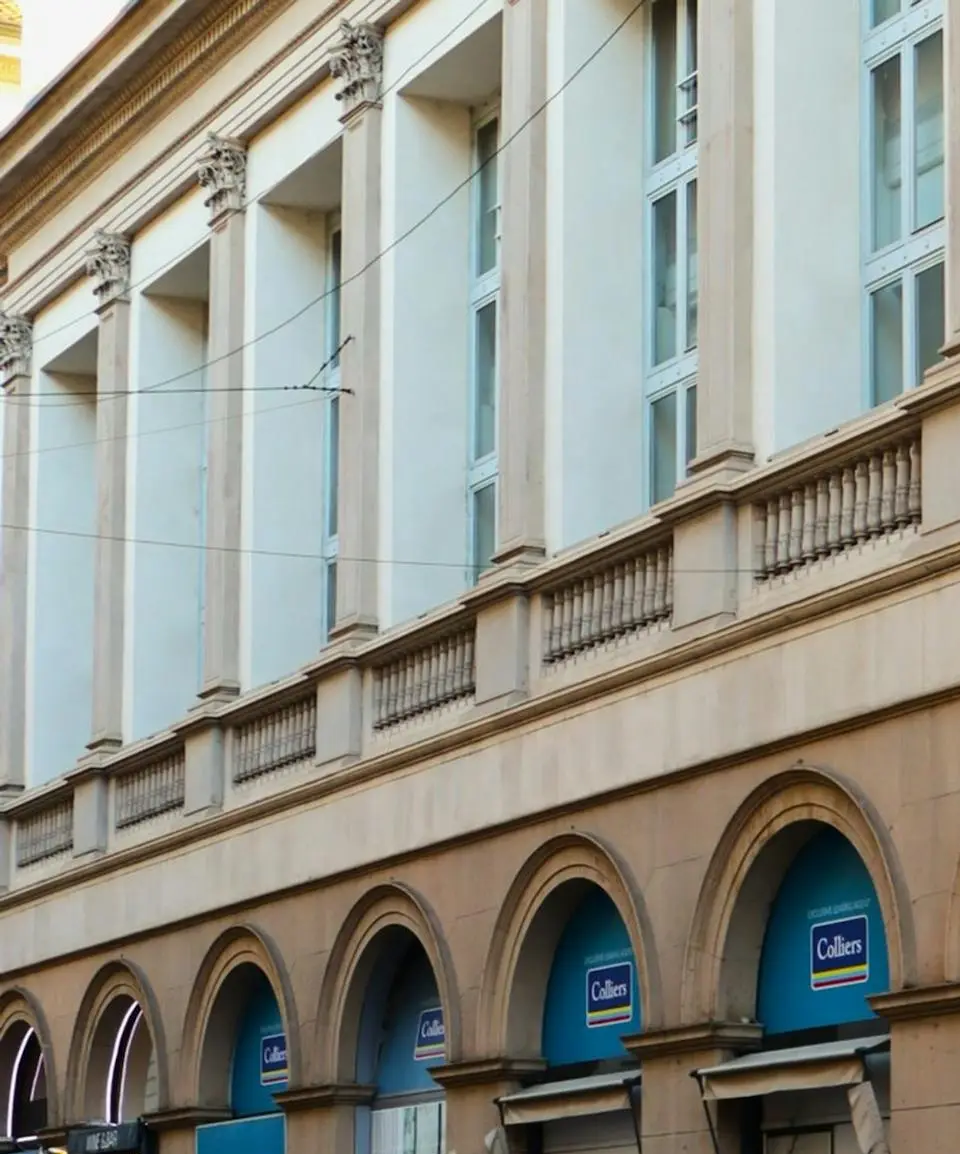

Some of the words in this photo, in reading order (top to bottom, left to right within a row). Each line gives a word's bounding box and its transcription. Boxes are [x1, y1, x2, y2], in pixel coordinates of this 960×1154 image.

[817, 934, 863, 960] Colliers
[591, 979, 628, 1001] Colliers
[421, 1019, 445, 1038] Collie
